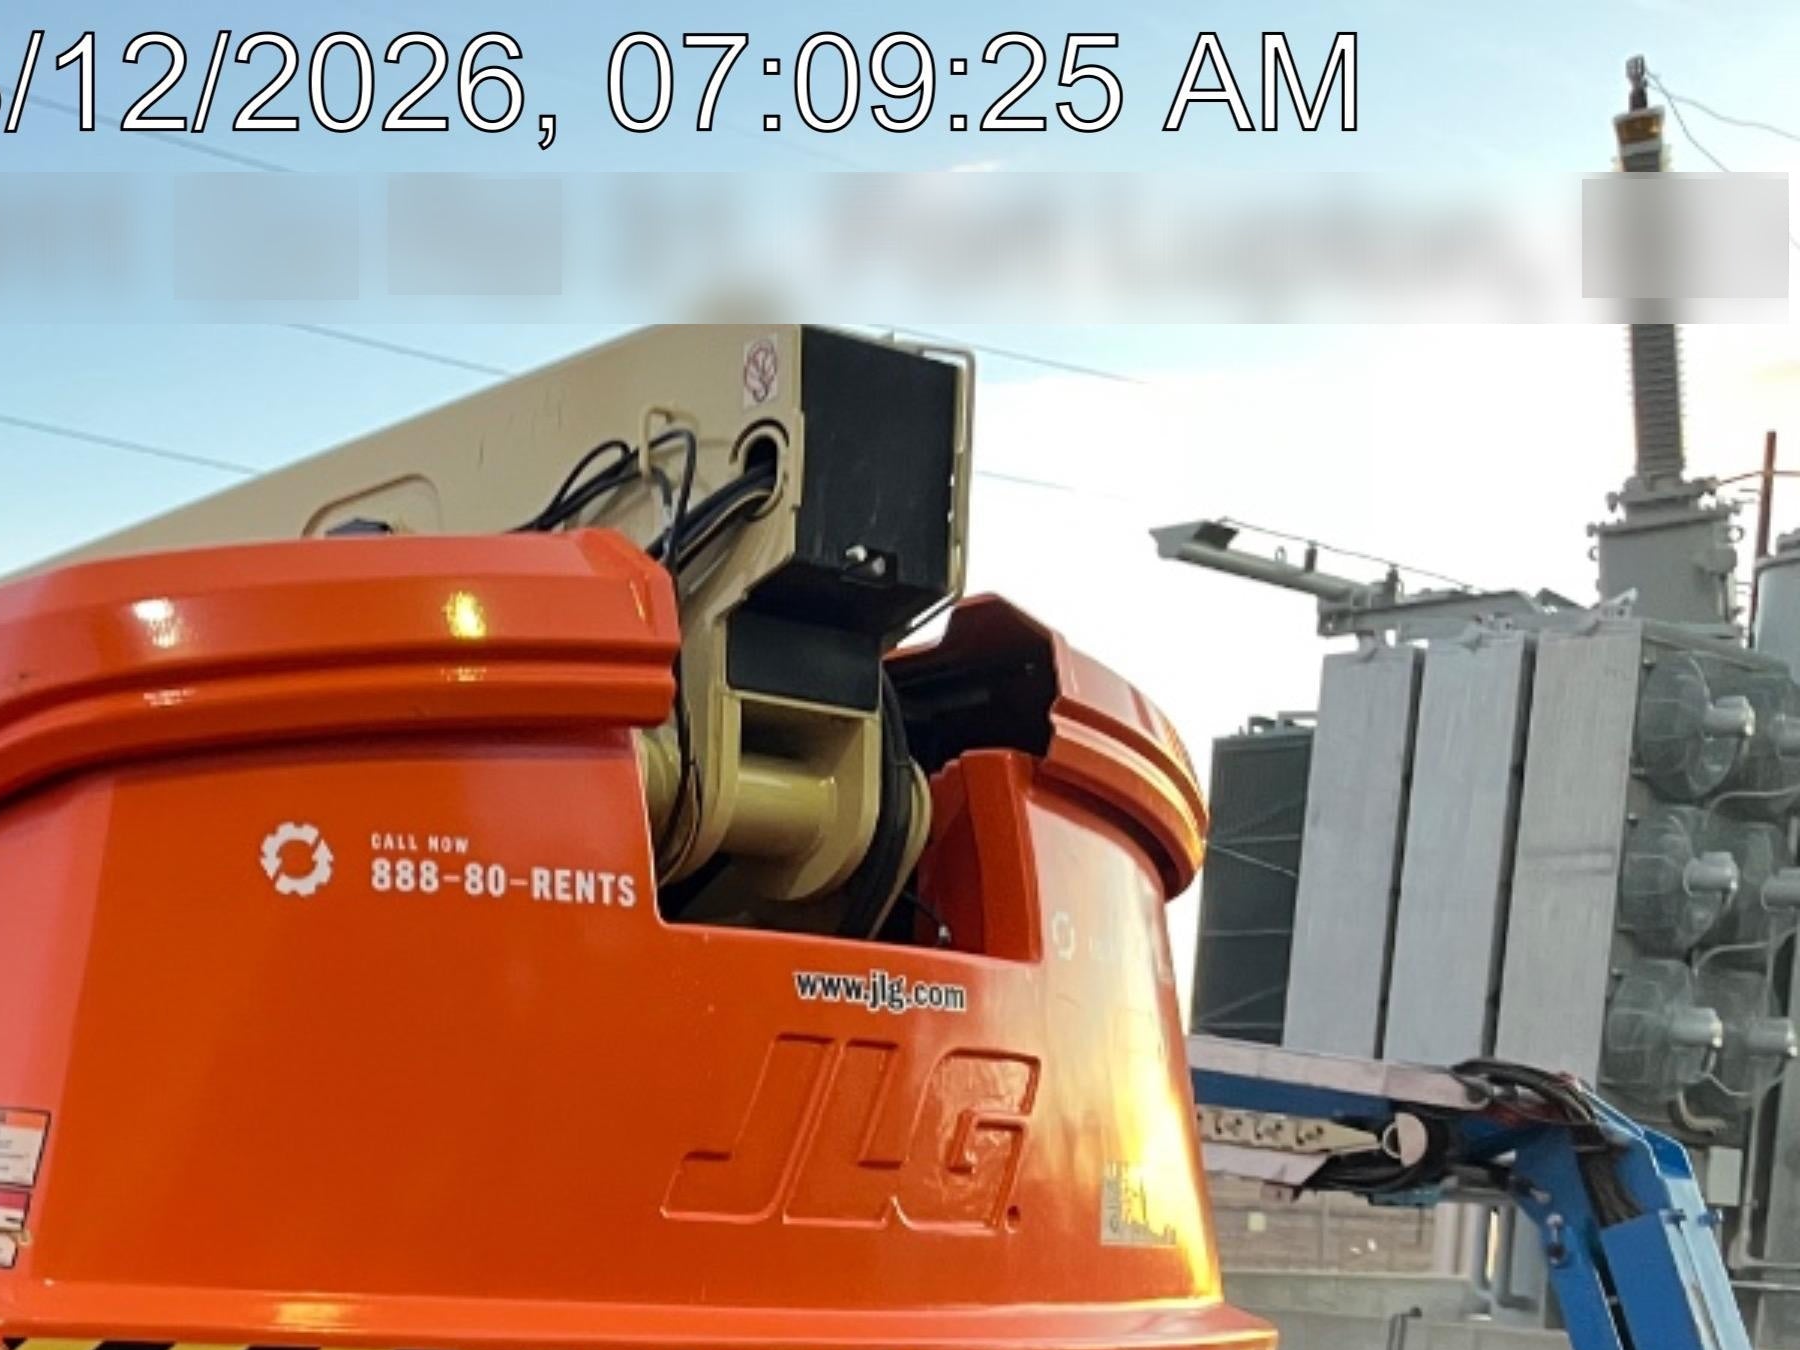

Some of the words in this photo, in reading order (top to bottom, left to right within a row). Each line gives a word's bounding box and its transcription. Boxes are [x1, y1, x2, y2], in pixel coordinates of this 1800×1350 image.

[371, 832, 418, 851] CALL
[428, 835, 469, 854] NOW
[371, 857, 637, 907] 888-80-RENTS
[792, 968, 967, 1014] www.jlg.com
[660, 1031, 1041, 1236] JLG
